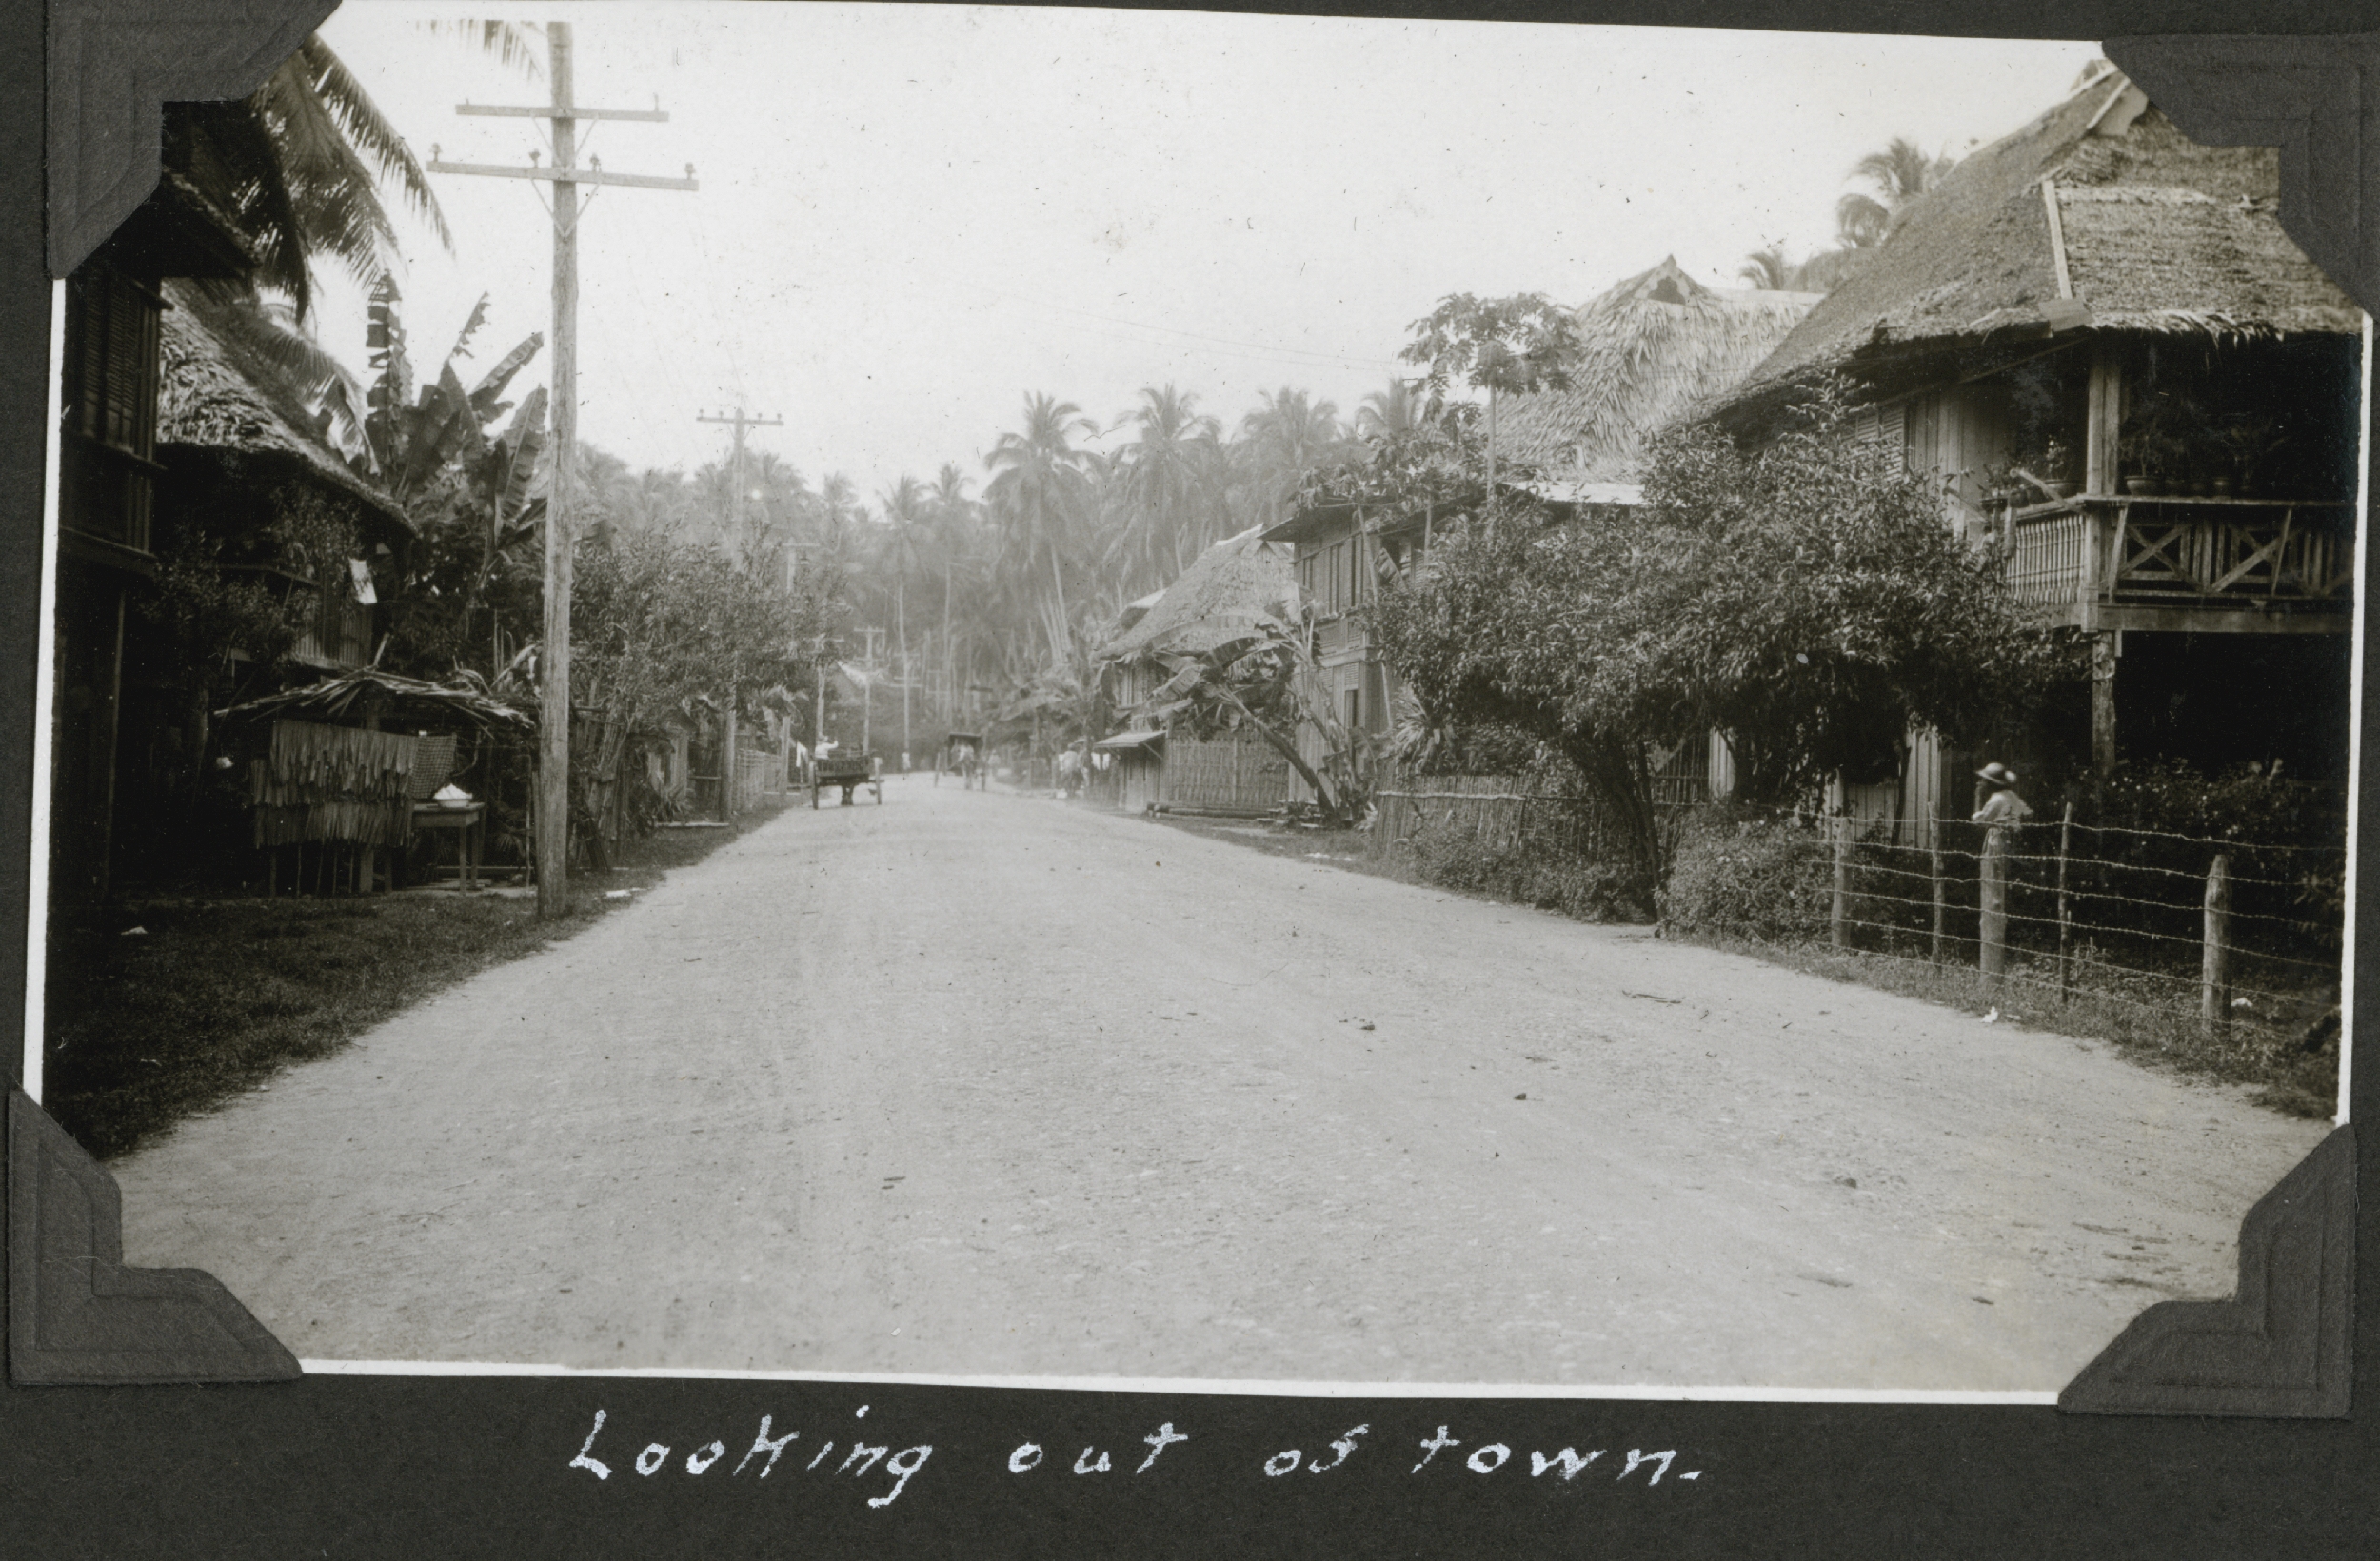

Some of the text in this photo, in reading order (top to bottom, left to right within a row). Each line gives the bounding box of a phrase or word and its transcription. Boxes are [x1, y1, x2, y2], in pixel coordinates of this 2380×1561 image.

[568, 1406, 1703, 1510] Looking out of town.
